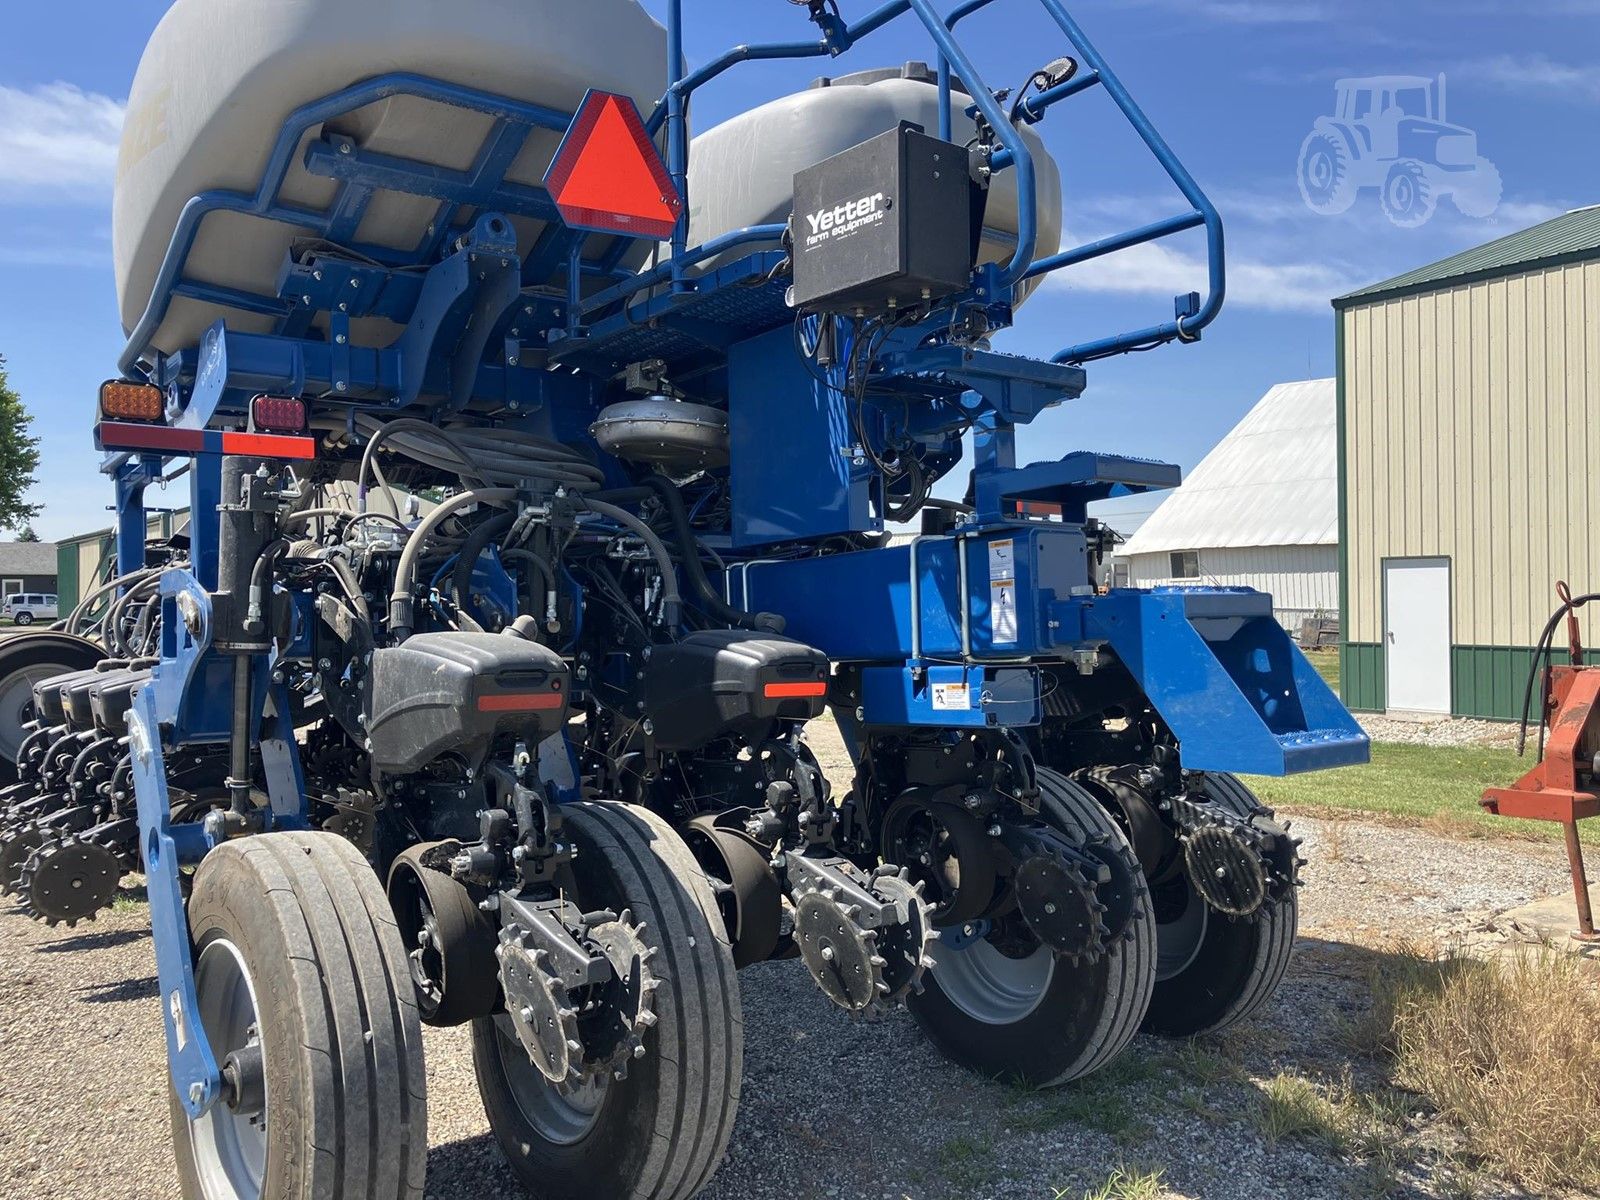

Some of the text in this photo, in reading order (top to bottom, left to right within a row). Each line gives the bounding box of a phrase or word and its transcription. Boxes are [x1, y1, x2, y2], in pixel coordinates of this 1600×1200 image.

[806, 192, 883, 235] Yetter
[806, 231, 829, 246] farm
[831, 210, 884, 236] equipment
